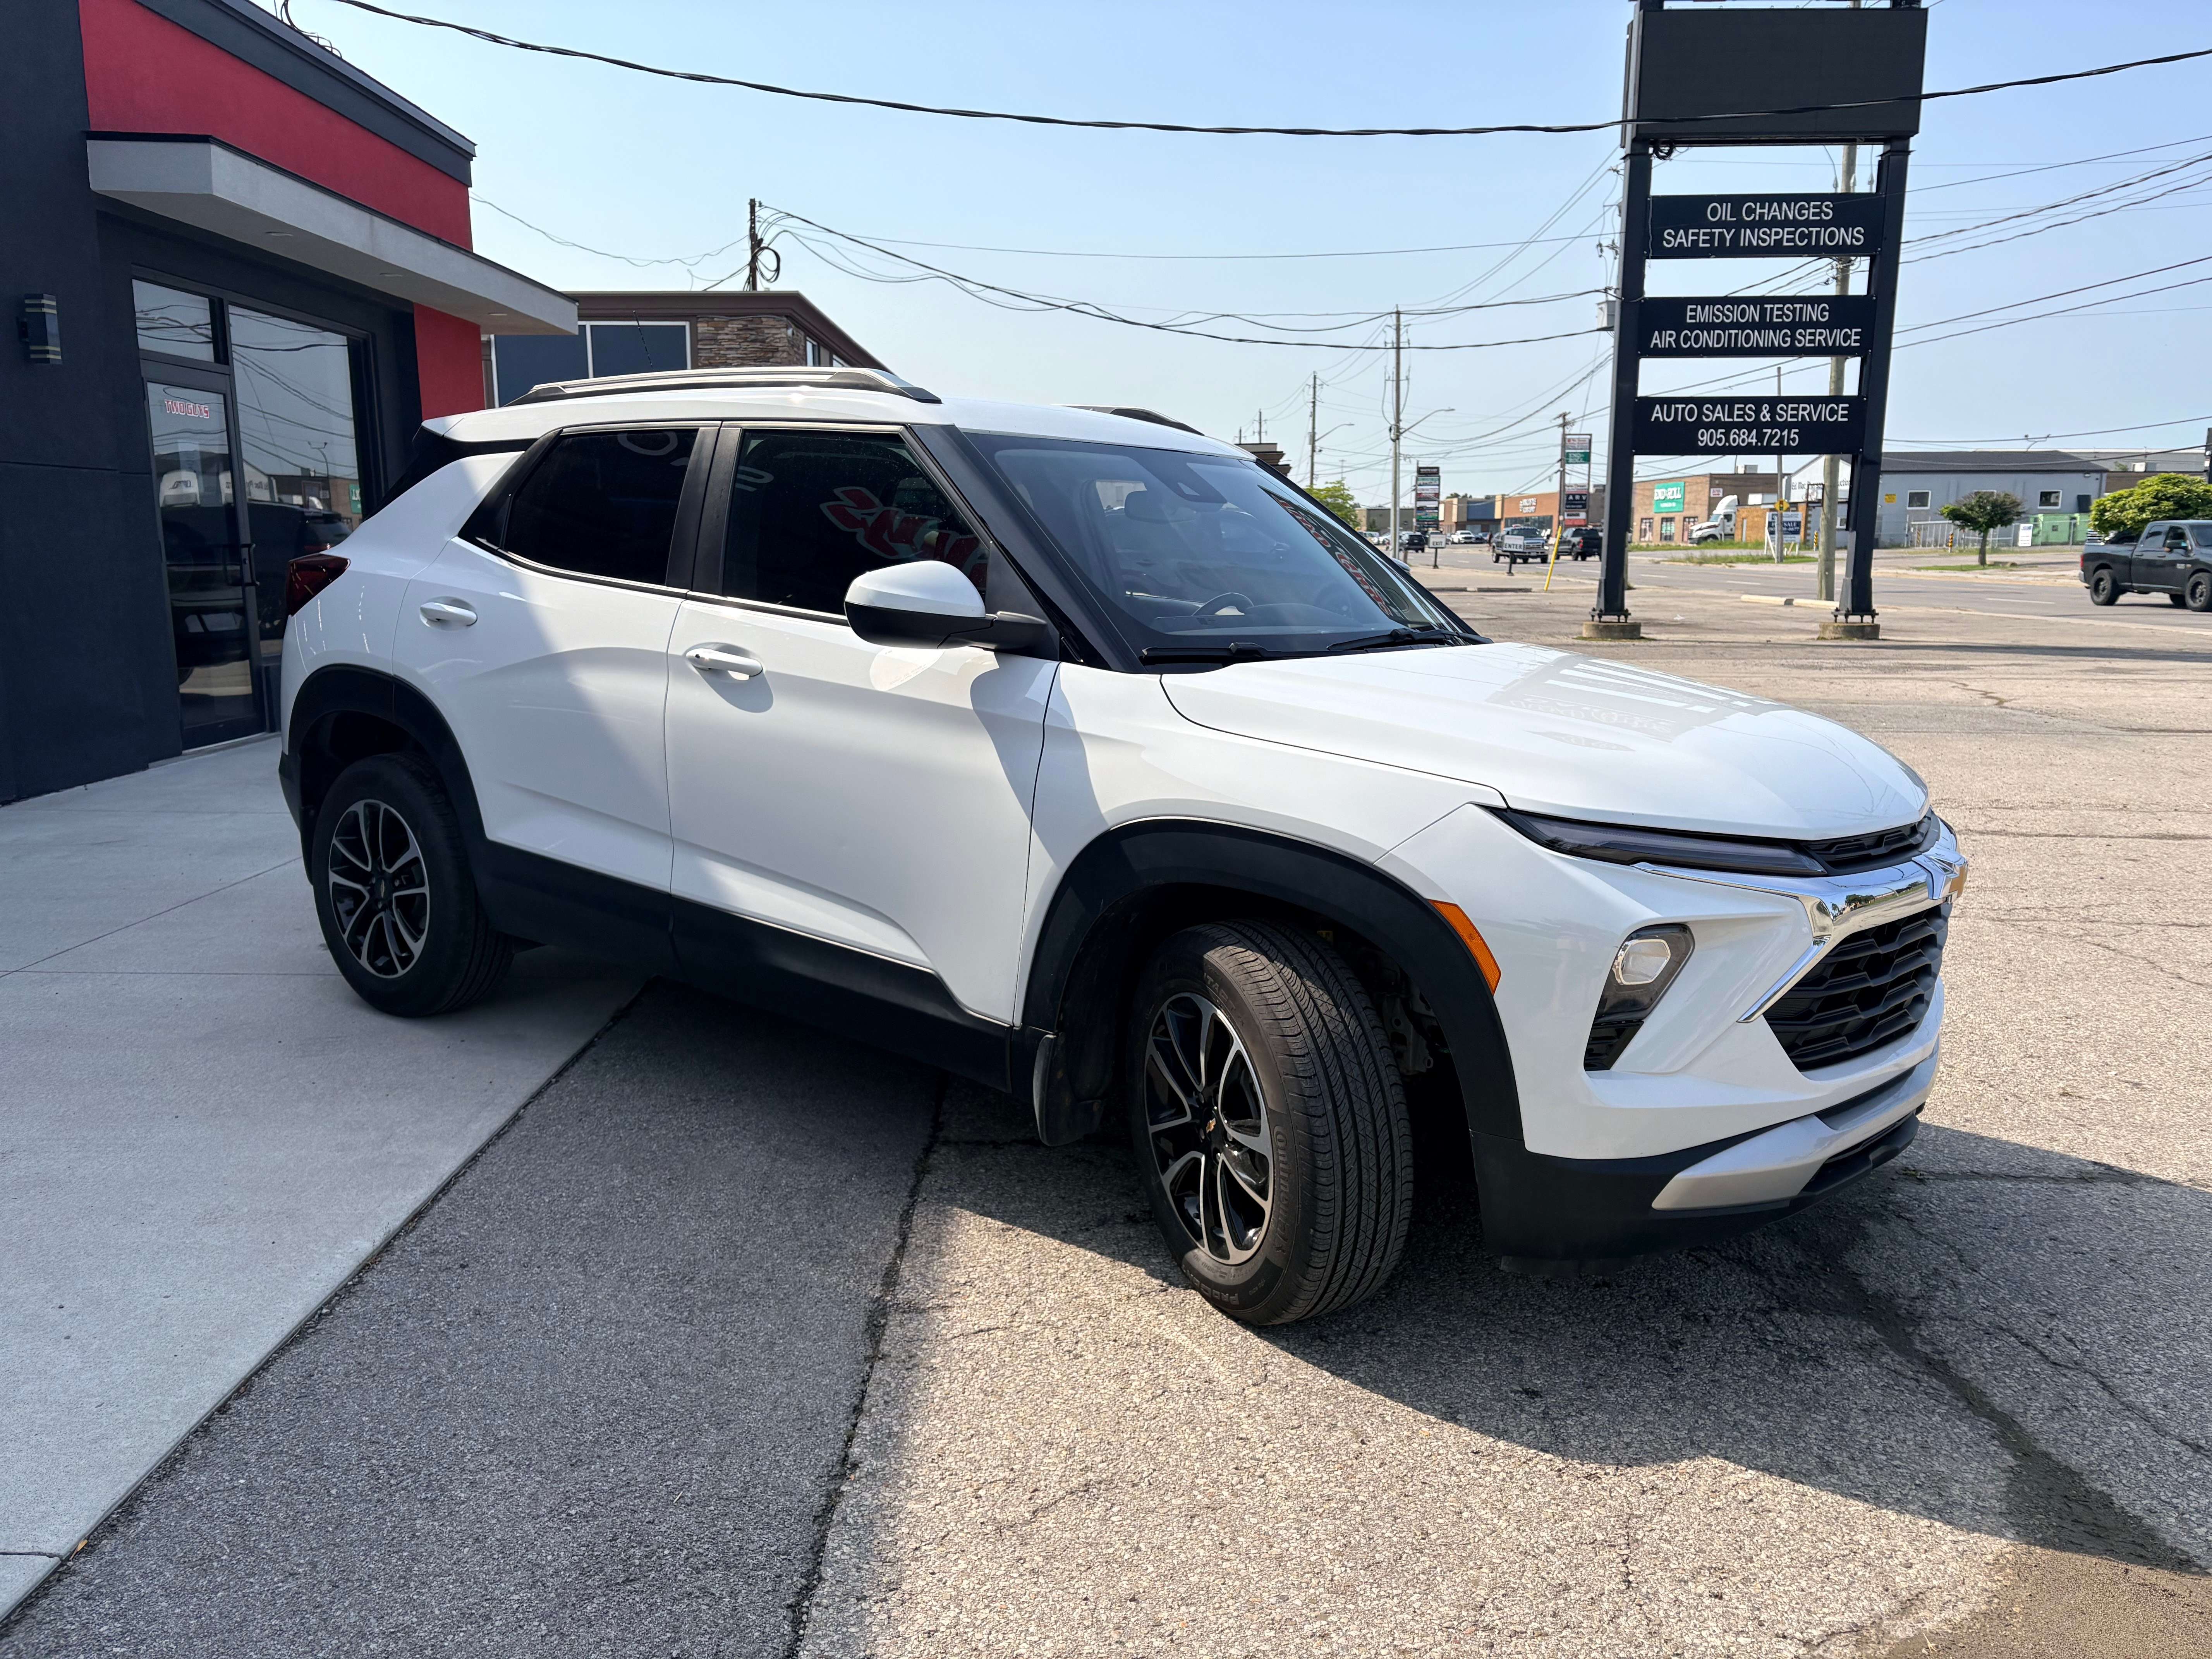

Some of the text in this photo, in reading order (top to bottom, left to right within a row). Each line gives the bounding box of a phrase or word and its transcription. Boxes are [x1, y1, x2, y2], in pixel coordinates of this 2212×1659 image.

[1707, 201, 1834, 222] OIL CHANGES
[1662, 227, 1865, 248] SAFETY INSPECTIONS
[1686, 303, 1829, 323] EMISSION TESTING
[1650, 328, 1862, 348] AIR CONDITIONING SERVICE
[164, 399, 210, 419] TWO GUYS
[1650, 403, 1850, 422] AUTO SALES & SERVICE
[1697, 429, 1800, 447] 905.684.7215
